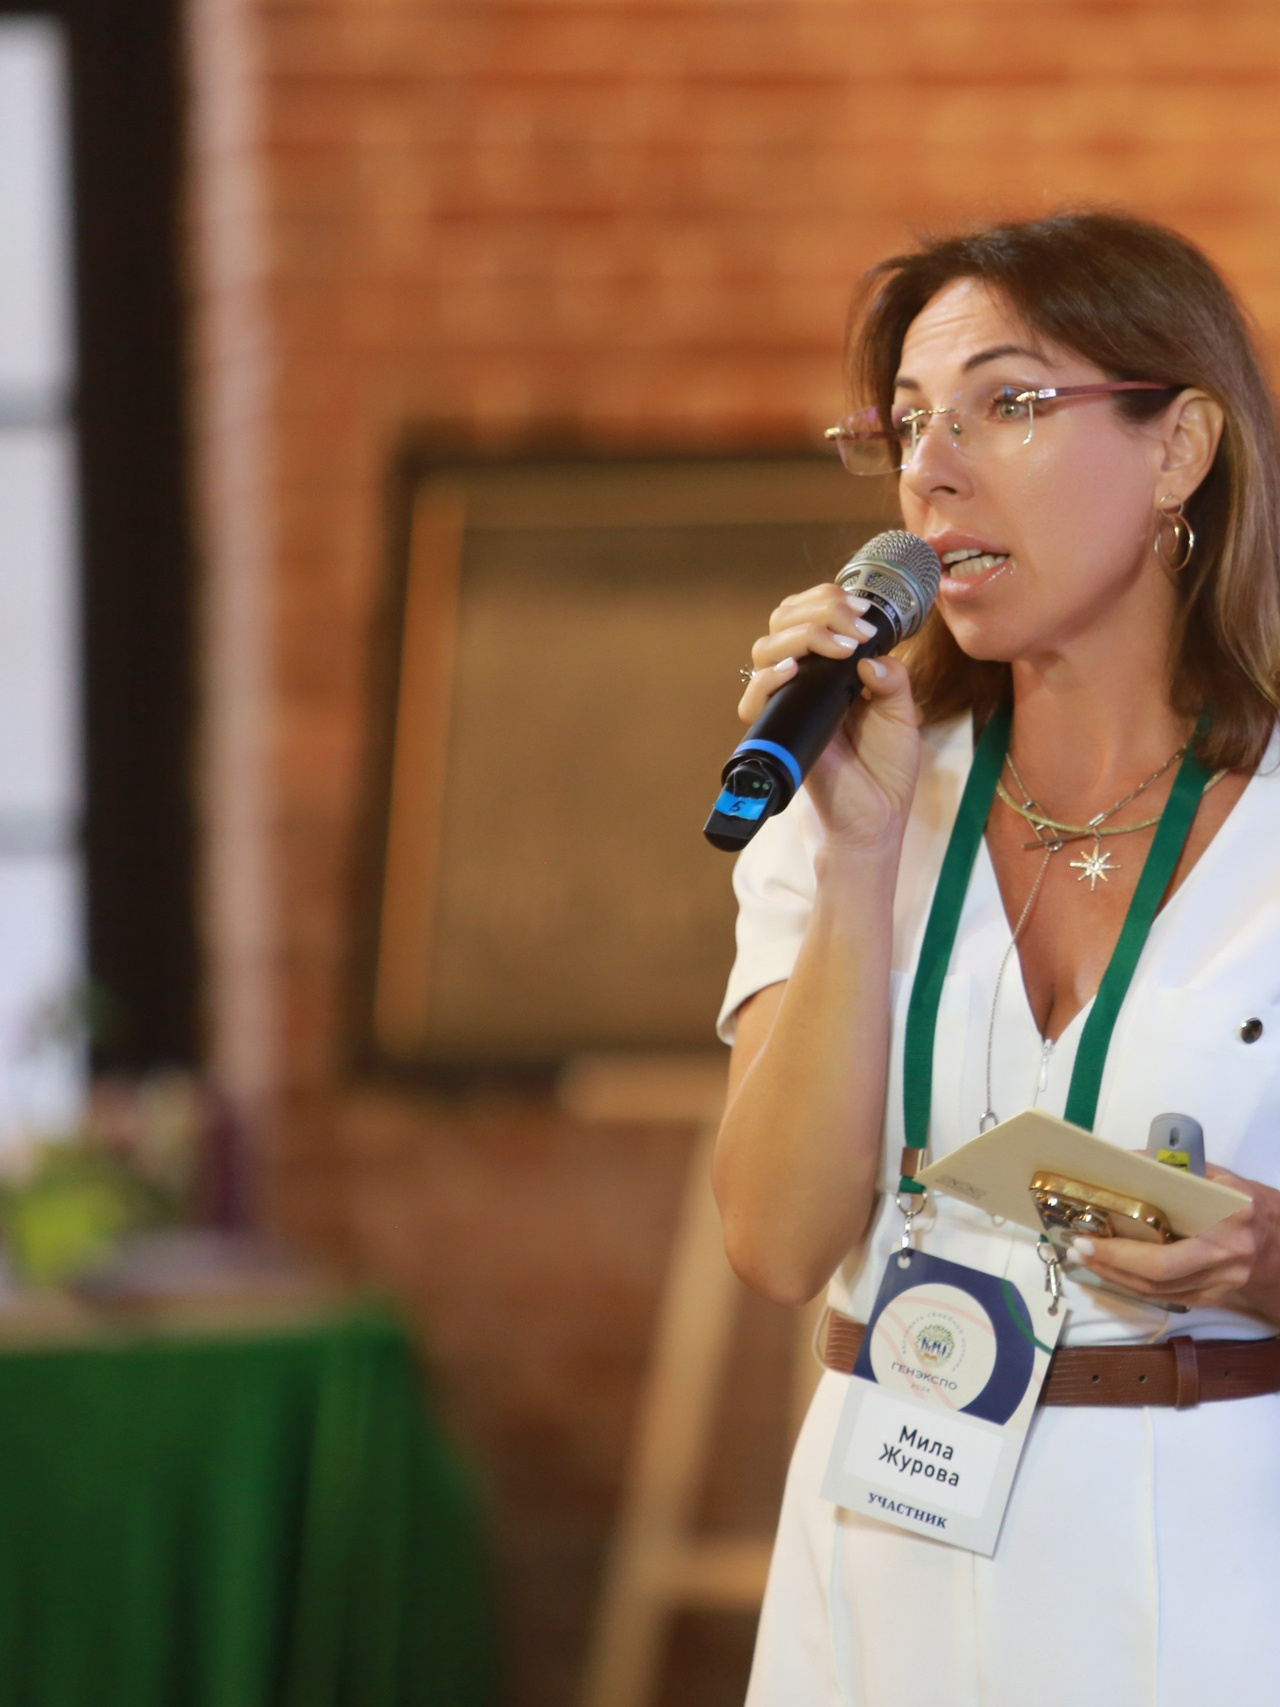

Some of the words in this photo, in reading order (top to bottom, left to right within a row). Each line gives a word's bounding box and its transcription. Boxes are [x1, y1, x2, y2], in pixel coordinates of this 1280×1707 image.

[729, 800, 746, 812] 5
[891, 1362, 958, 1391] ГЕНЭКСПО
[898, 1424, 954, 1461] Мила
[878, 1442, 960, 1488] Журова
[867, 1491, 948, 1530] УЧАСТНИК
